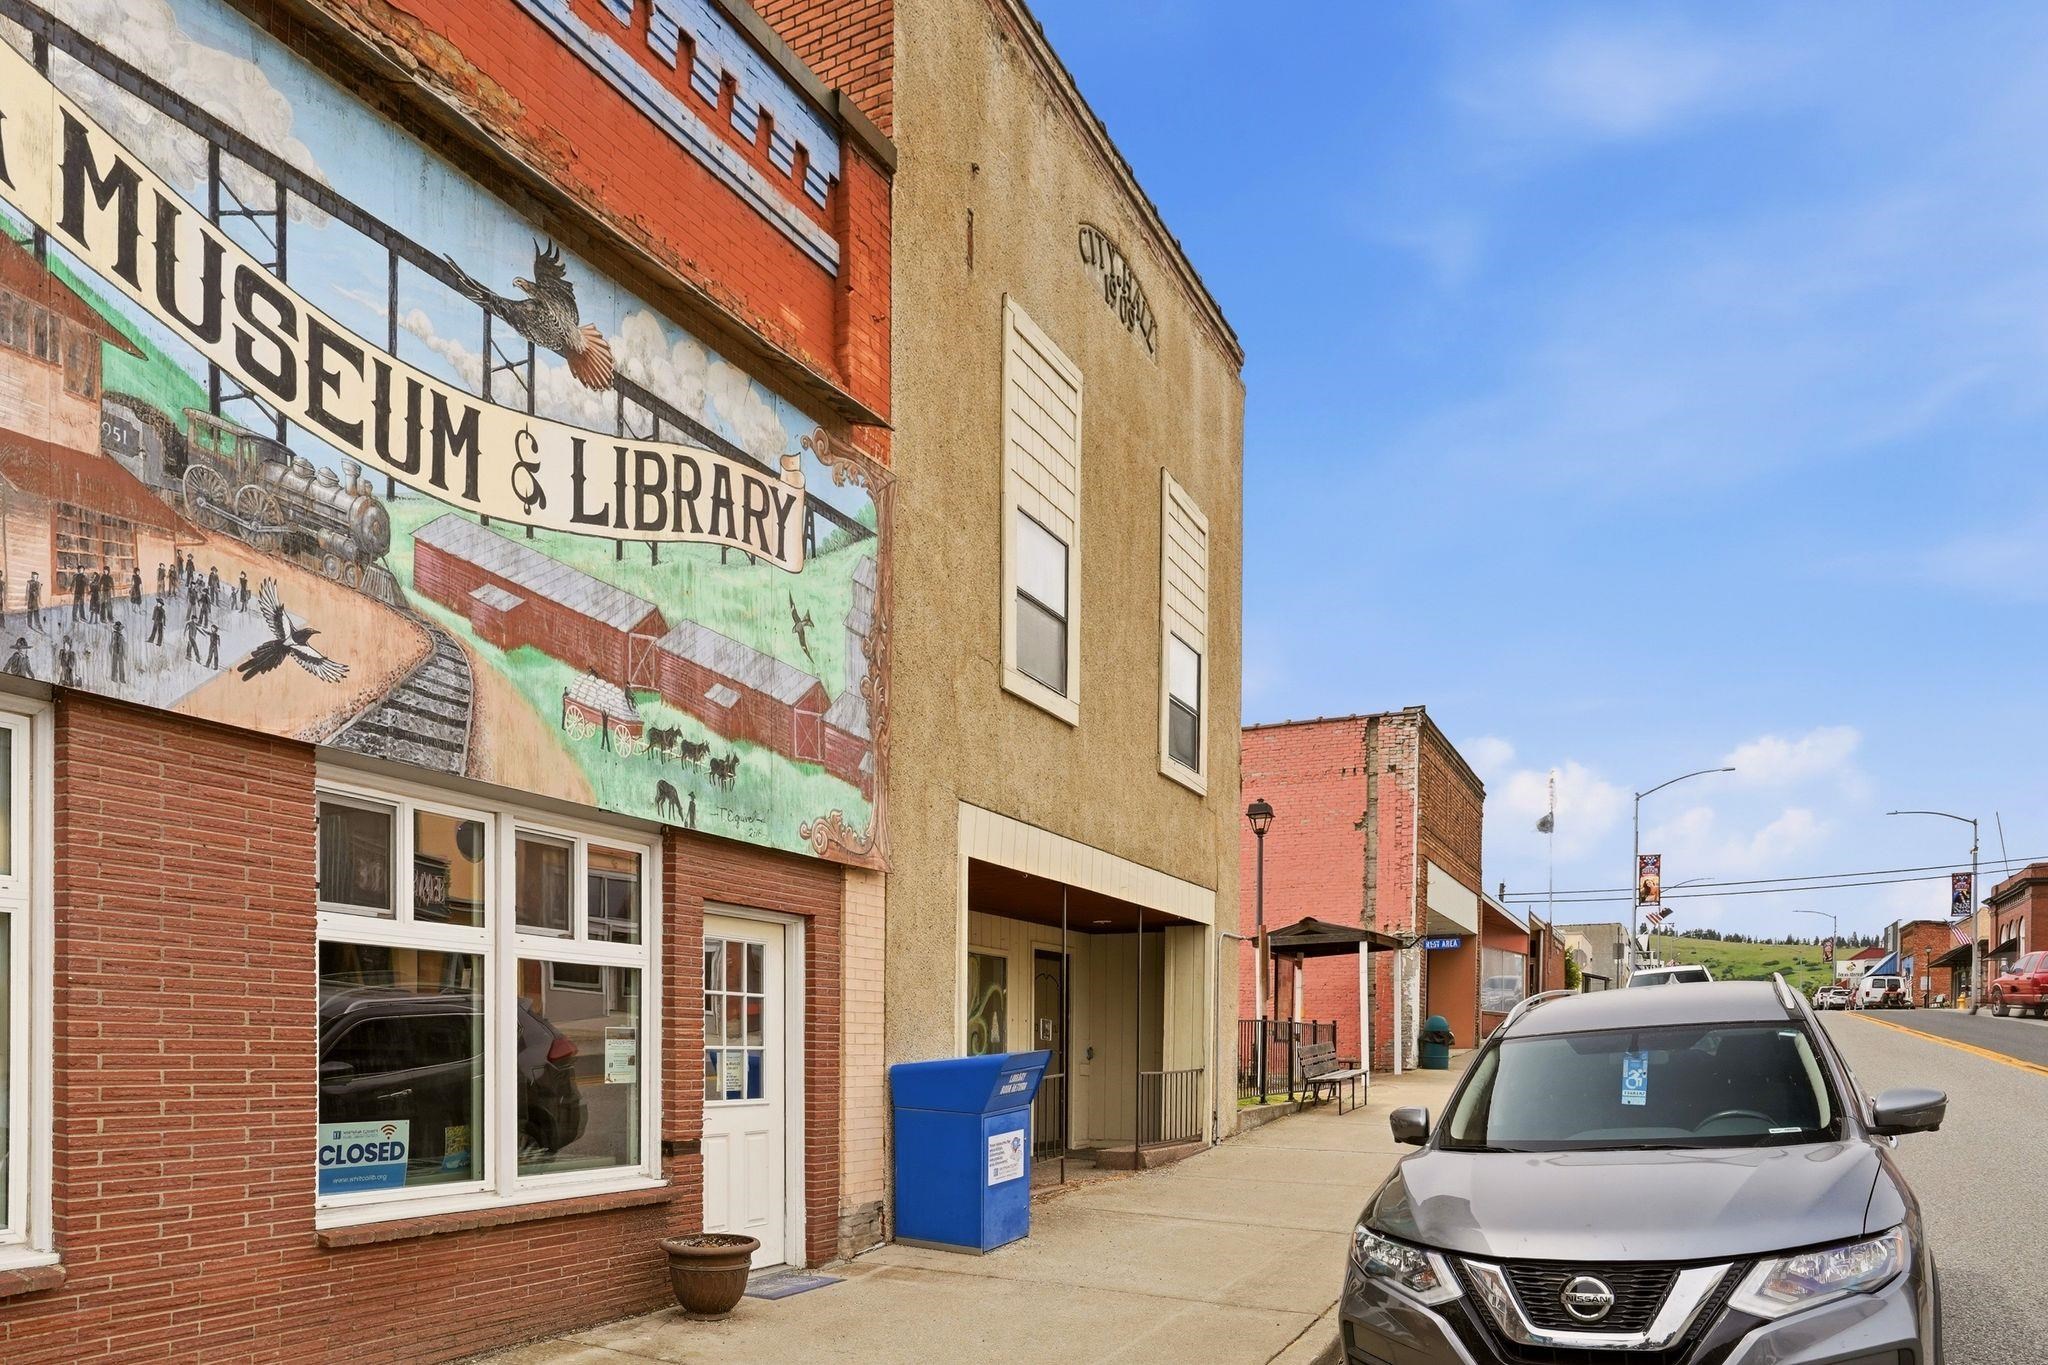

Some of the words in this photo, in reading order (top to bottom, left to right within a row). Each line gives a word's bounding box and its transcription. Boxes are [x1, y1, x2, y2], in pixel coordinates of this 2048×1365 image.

[58, 104, 481, 503] MUSEUM
[511, 422, 547, 516] &
[570, 436, 797, 562] LIBRARY
[101, 421, 128, 446] 951
[1441, 939, 1459, 949] AREA
[319, 1141, 405, 1166] CLOSED
[1565, 1295, 1608, 1303] NISSAN
